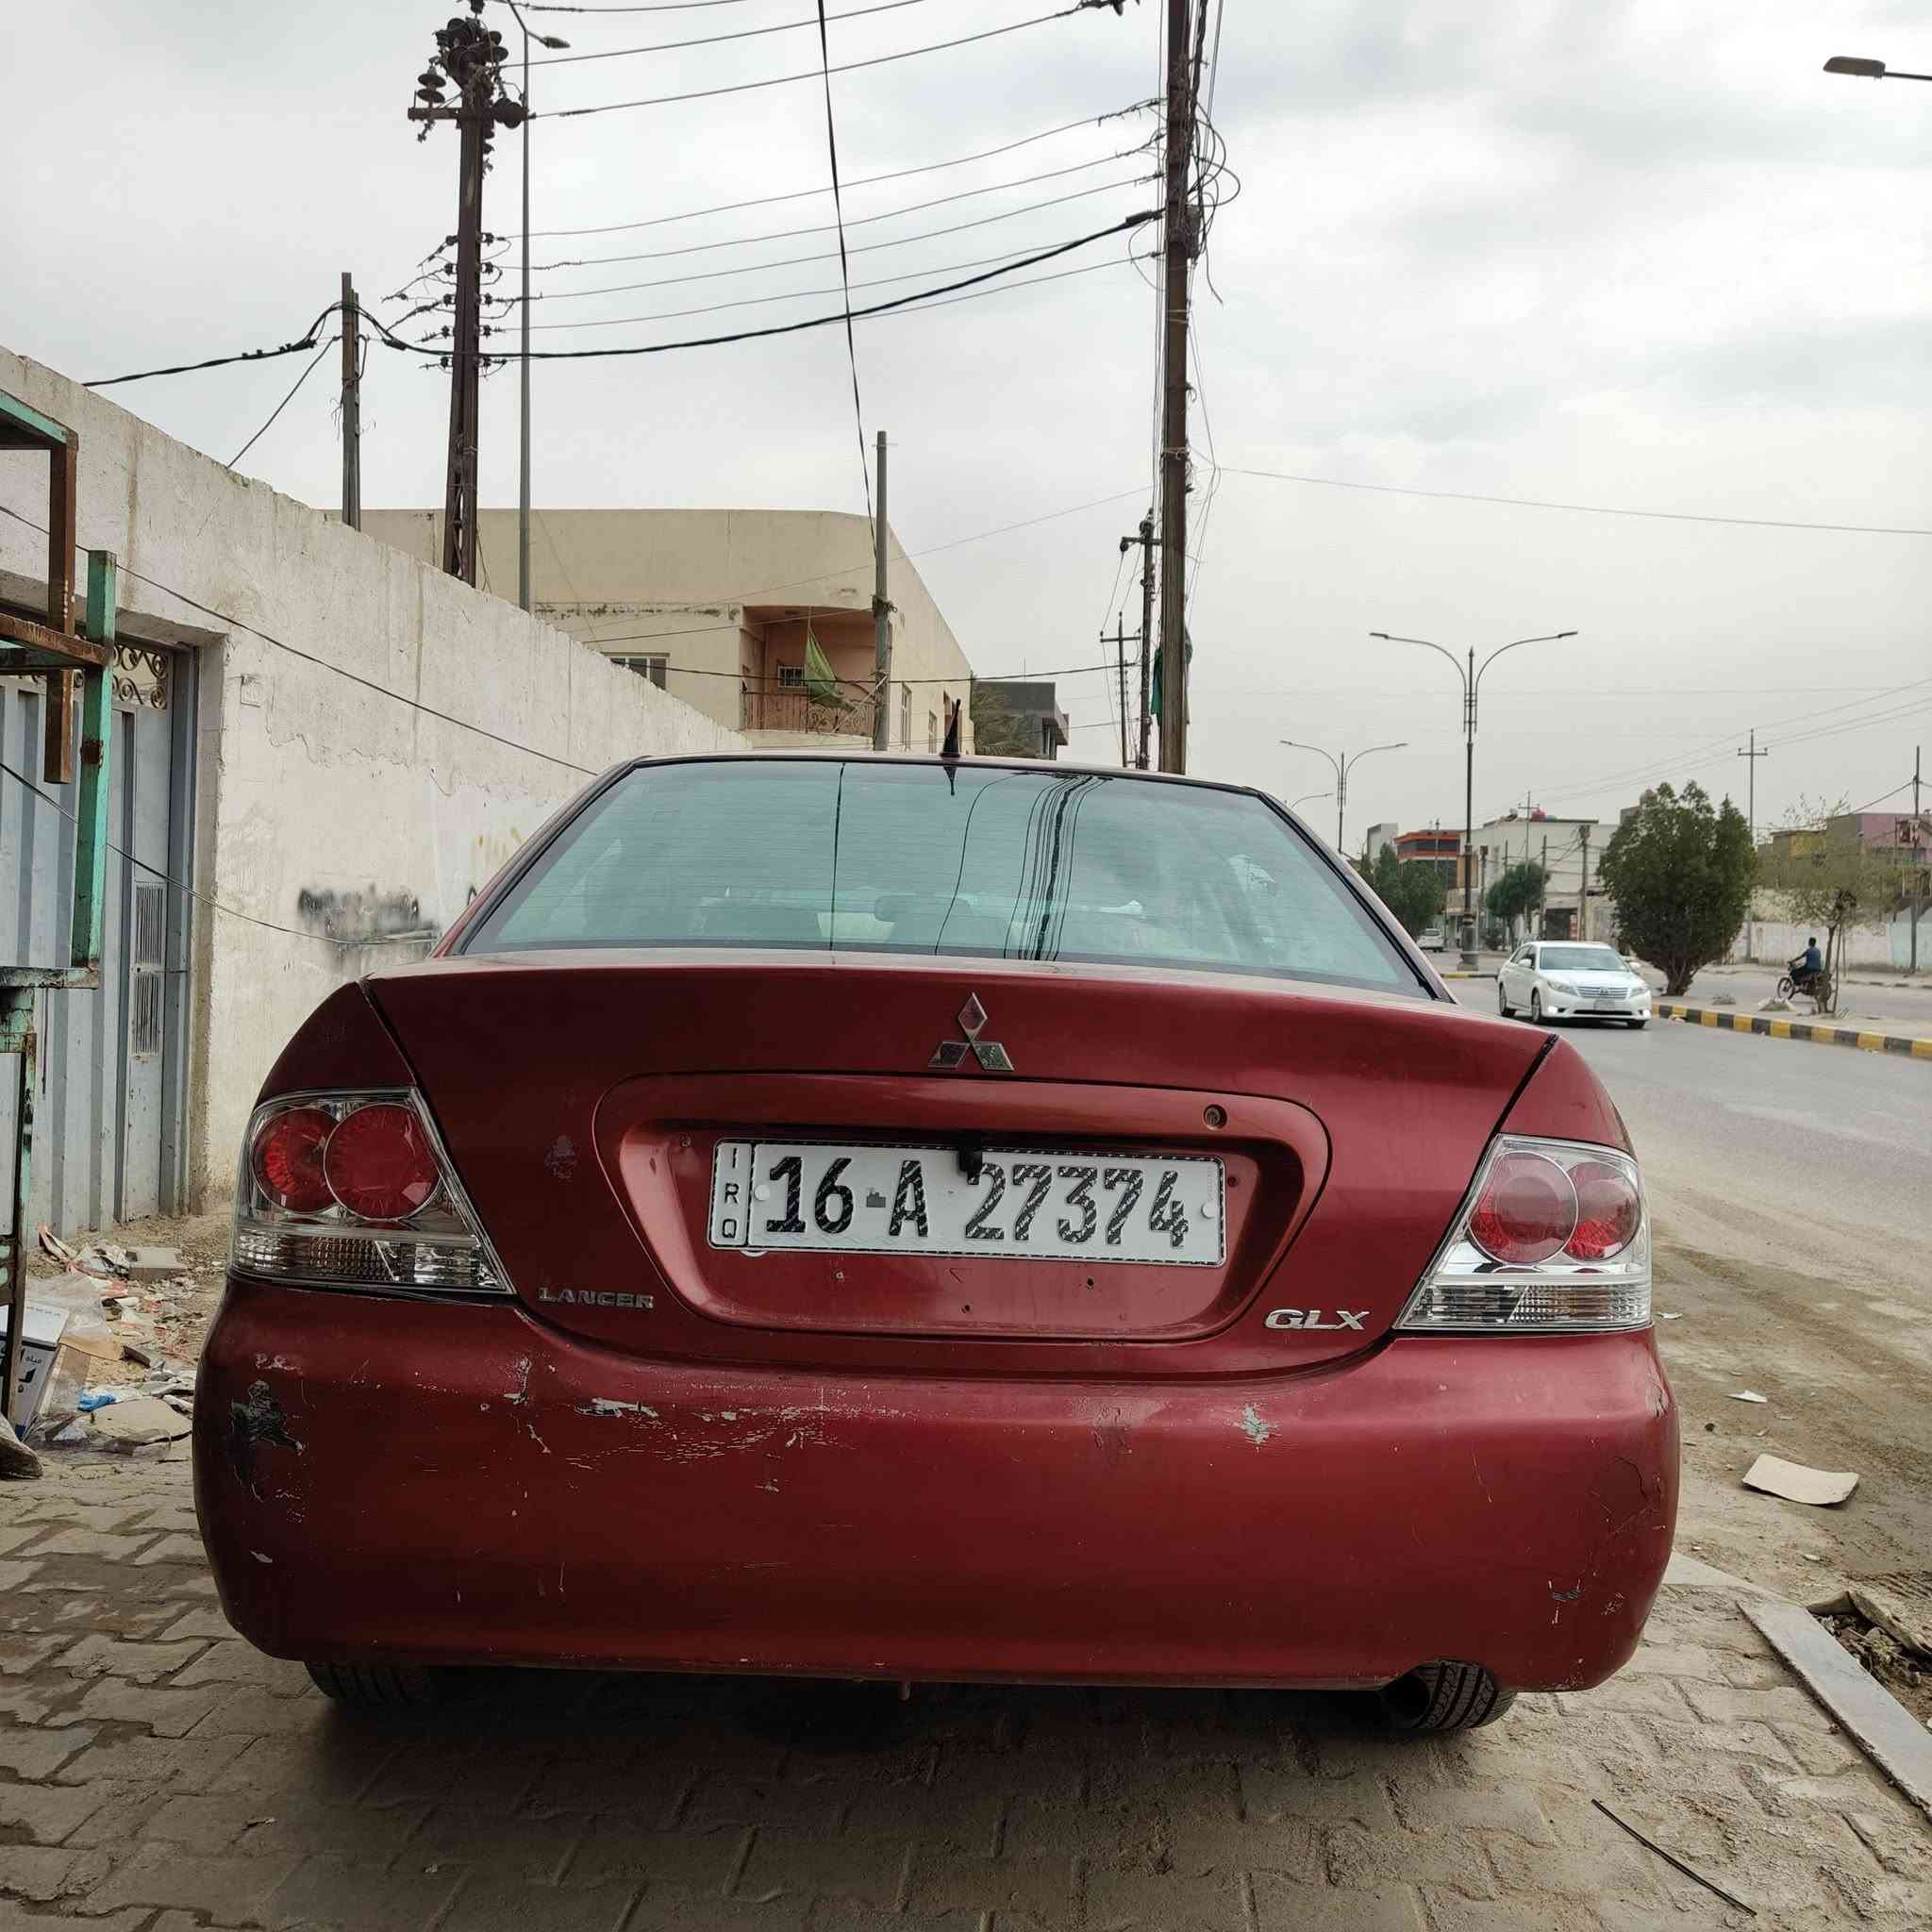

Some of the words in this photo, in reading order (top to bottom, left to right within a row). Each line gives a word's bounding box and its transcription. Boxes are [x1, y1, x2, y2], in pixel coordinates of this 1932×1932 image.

[766, 1156, 854, 1235] 16
[889, 1159, 928, 1238] A
[965, 1162, 1190, 1248] 27374
[538, 1286, 655, 1309] LANCER
[1264, 1308, 1371, 1331] GLX
